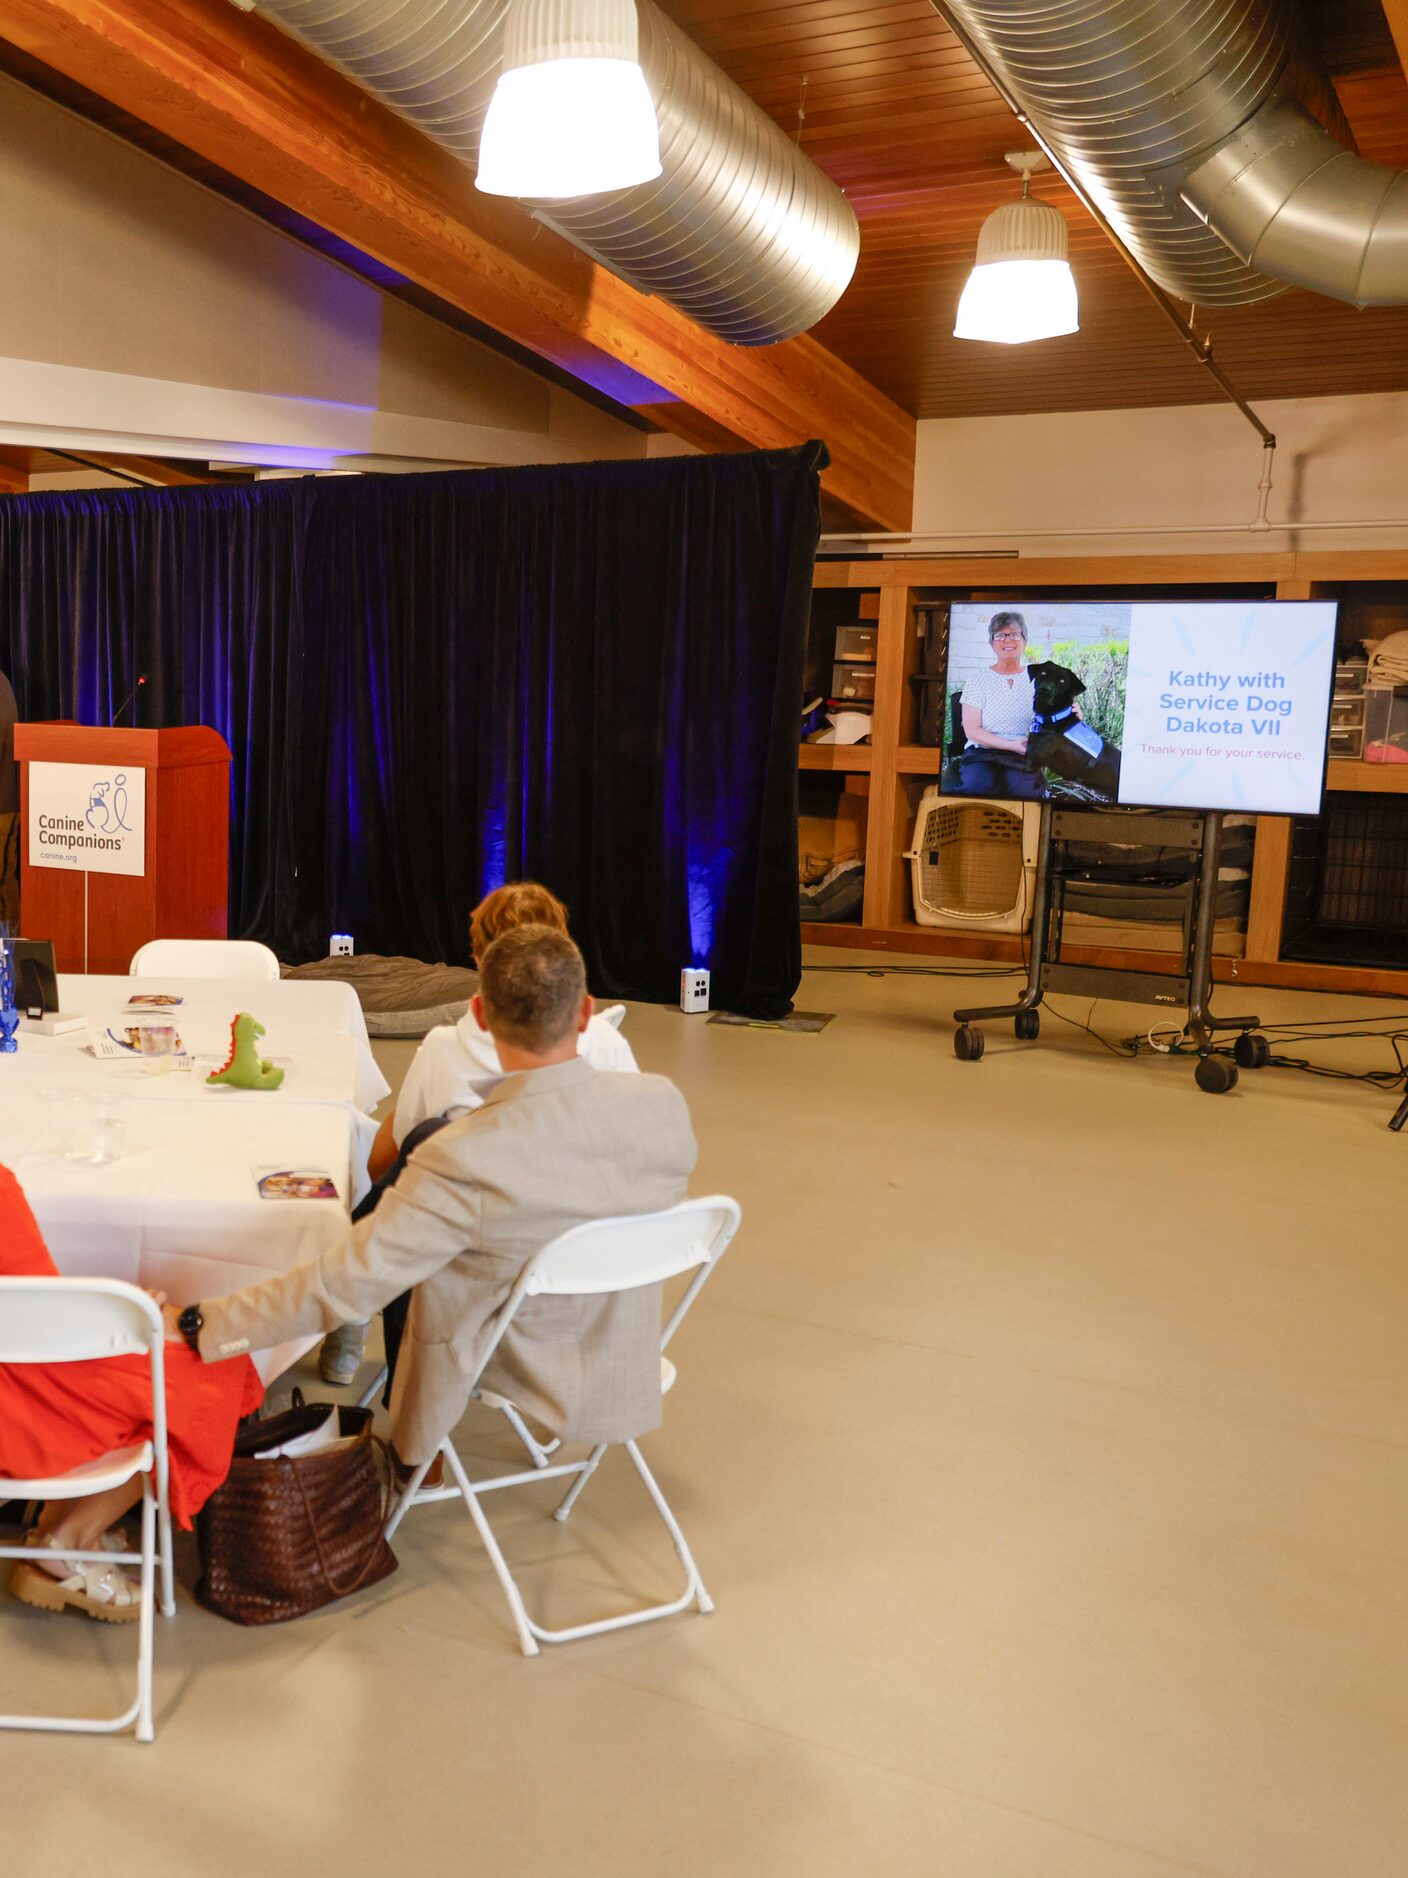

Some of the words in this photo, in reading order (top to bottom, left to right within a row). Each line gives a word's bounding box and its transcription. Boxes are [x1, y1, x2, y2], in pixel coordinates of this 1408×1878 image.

[1169, 670, 1231, 691] Kathy
[1238, 672, 1285, 688] with
[1160, 694, 1239, 711] Service
[1246, 696, 1292, 716] Dog
[1166, 716, 1243, 734] Dakota
[1251, 719, 1281, 736] VII
[1140, 744, 1176, 754] Thank
[1180, 747, 1202, 760] you
[1206, 746, 1222, 756] for
[1225, 749, 1253, 762] your
[1257, 750, 1305, 760] service.
[39, 814, 84, 832] Canine
[39, 830, 122, 850] Companions
[40, 852, 77, 863] canine.org
